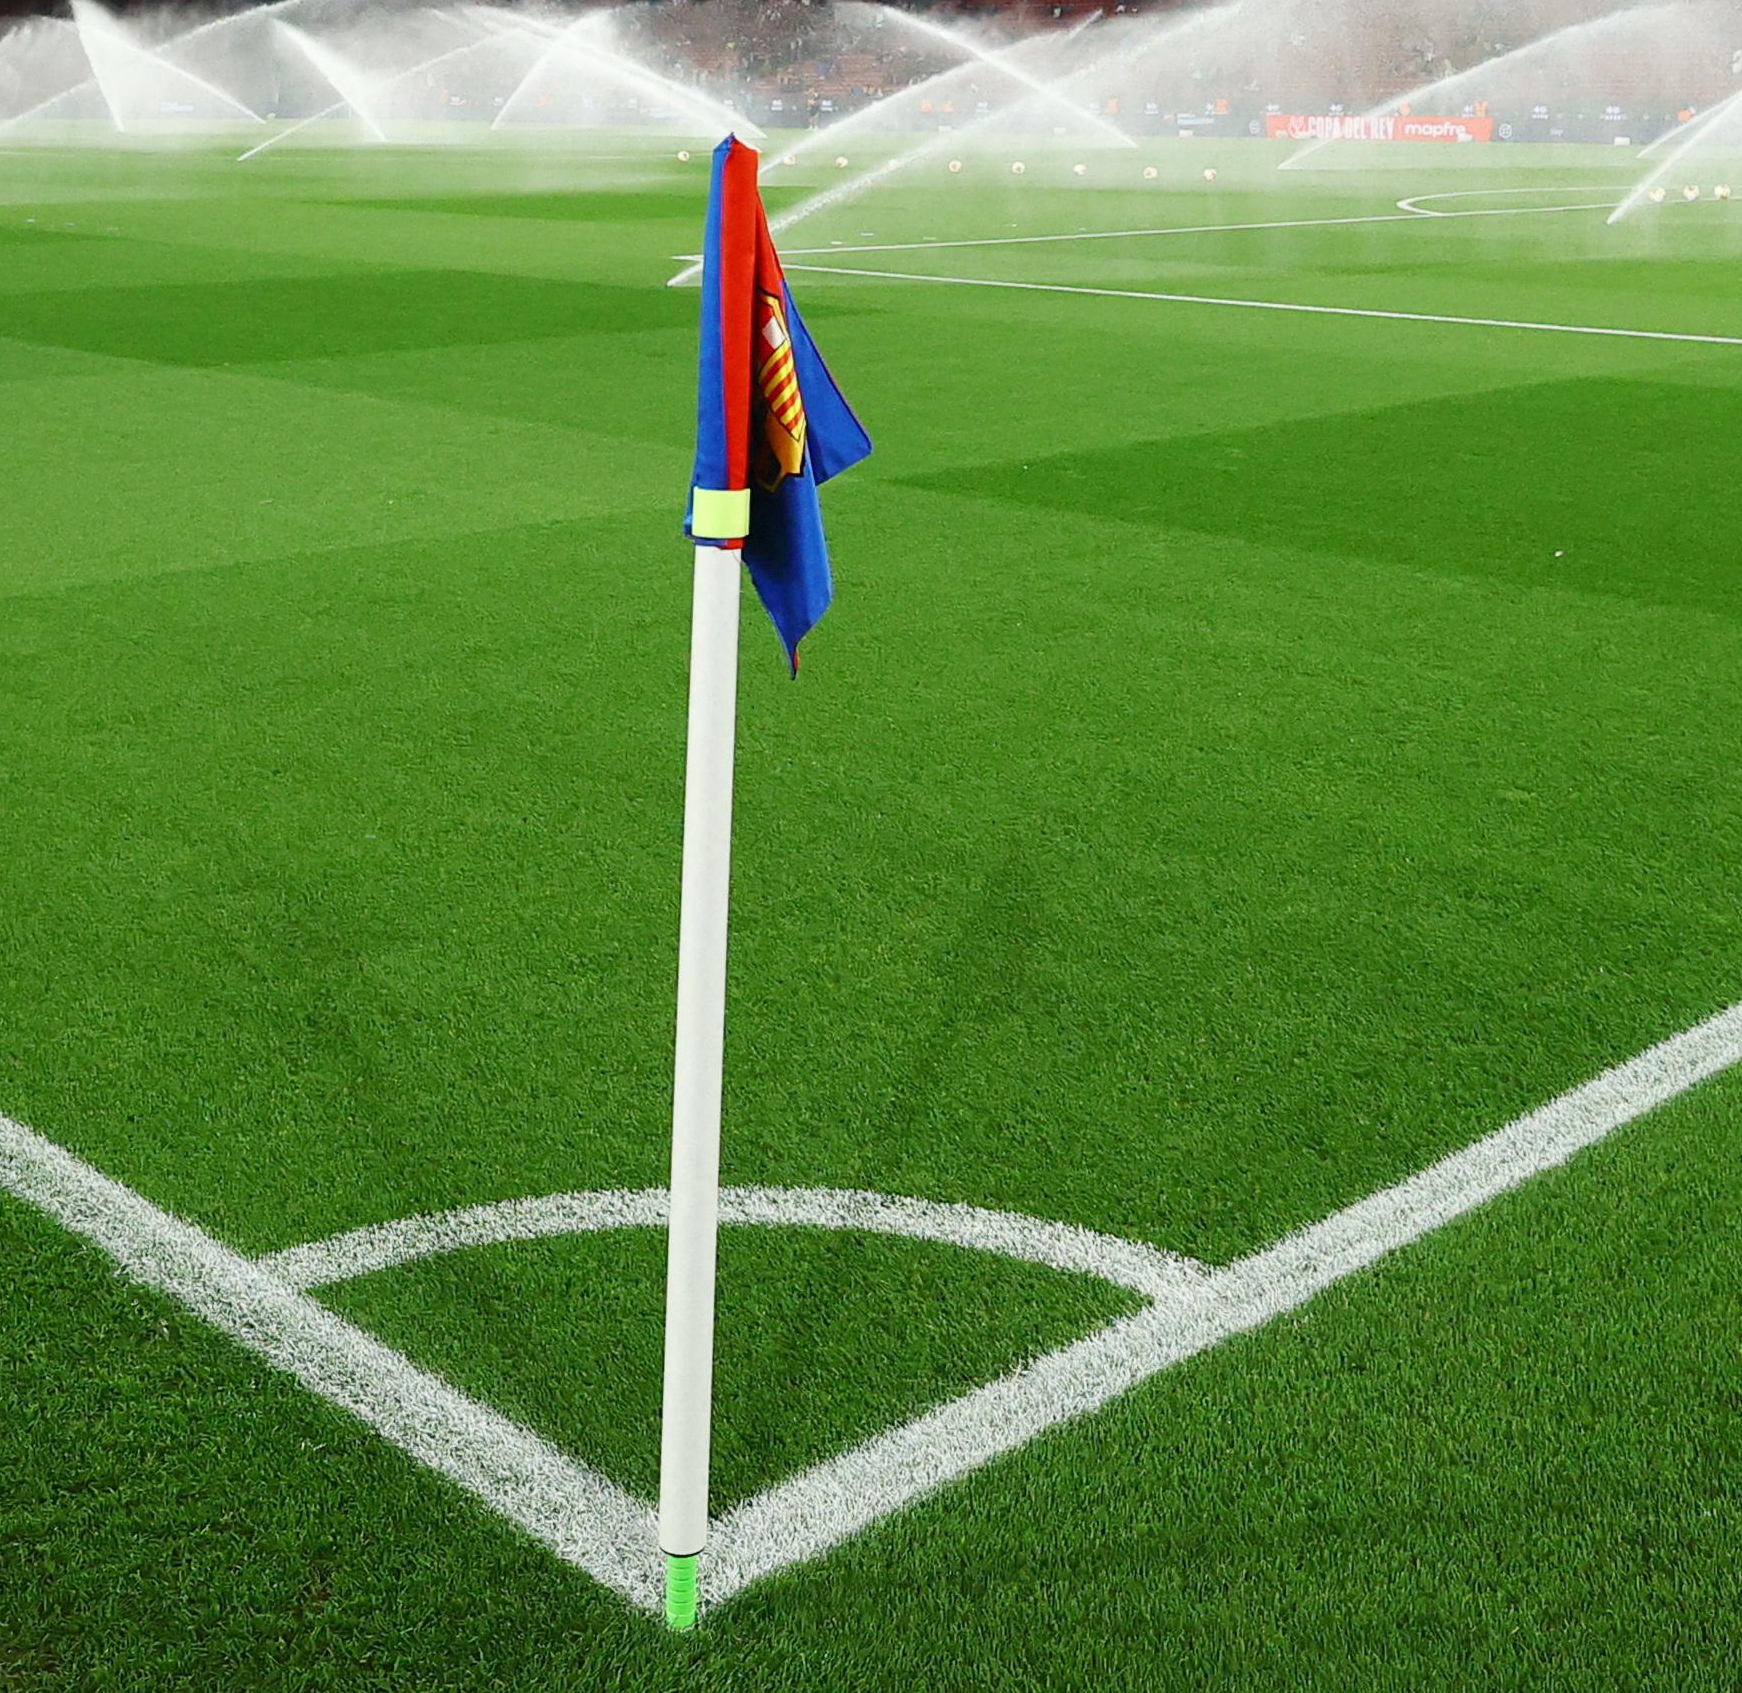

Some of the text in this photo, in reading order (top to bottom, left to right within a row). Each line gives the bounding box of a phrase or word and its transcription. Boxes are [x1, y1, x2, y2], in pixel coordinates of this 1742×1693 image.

[1308, 117, 1394, 139] COPA DEL REY
[1405, 121, 1466, 136] mapfre
